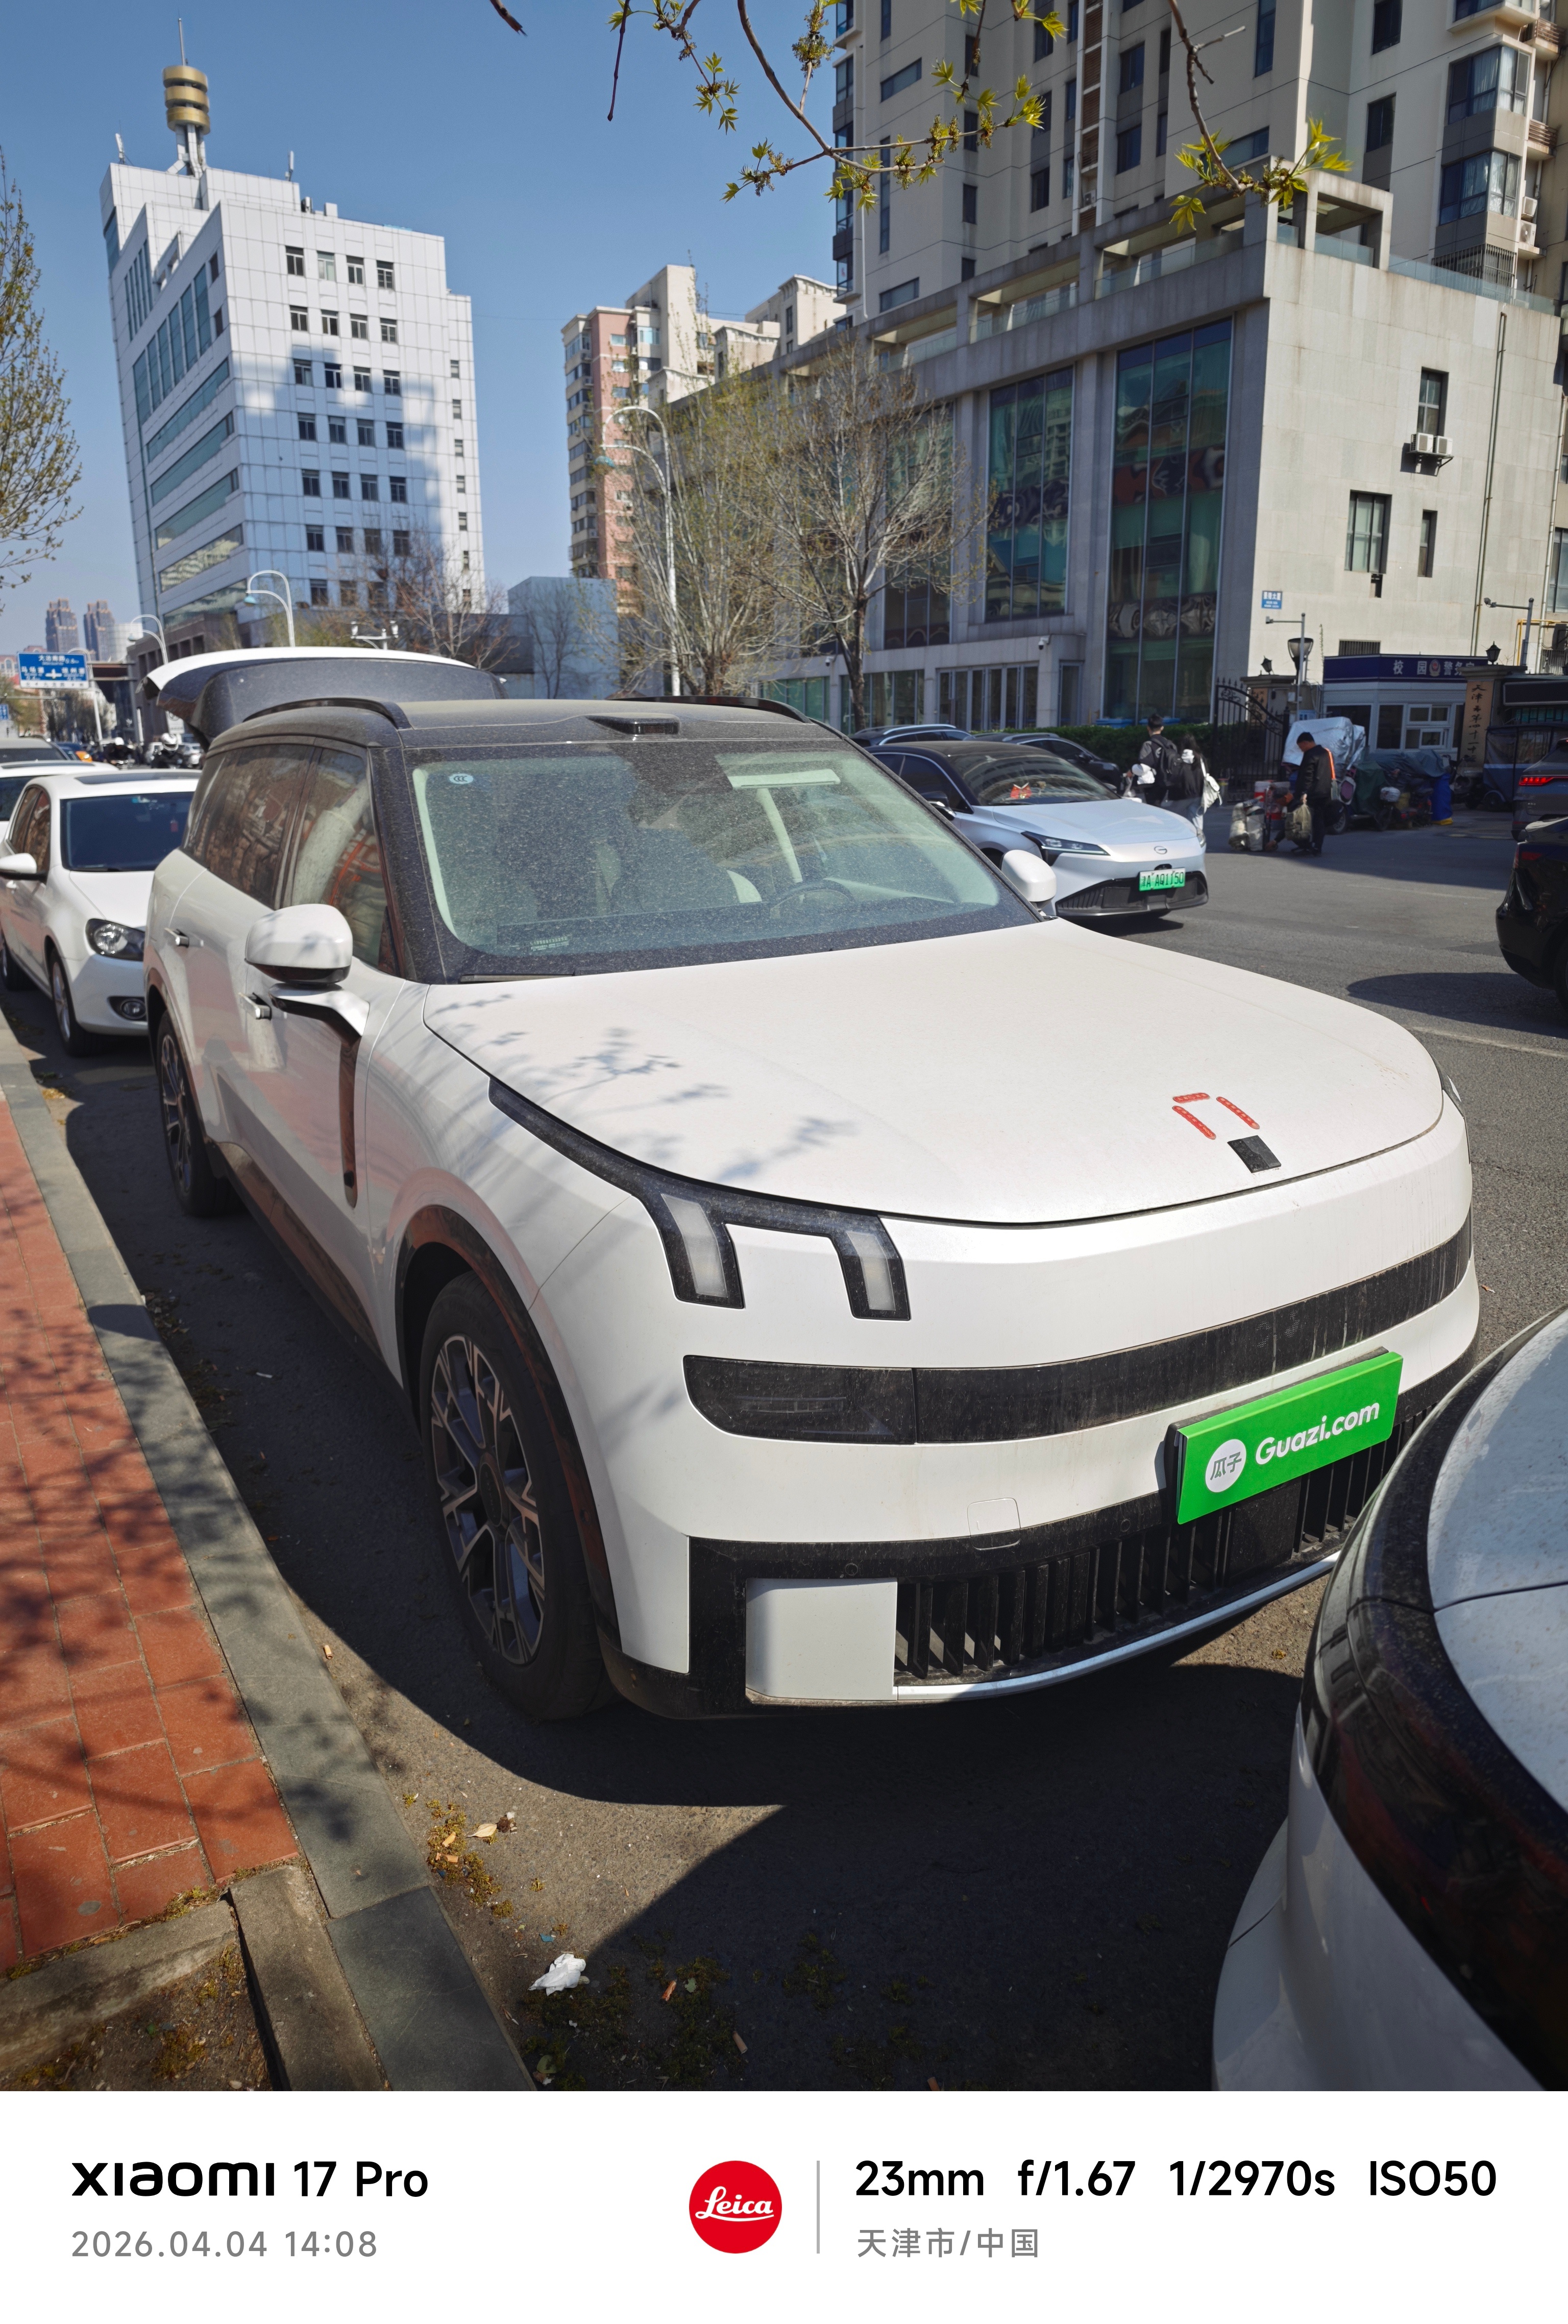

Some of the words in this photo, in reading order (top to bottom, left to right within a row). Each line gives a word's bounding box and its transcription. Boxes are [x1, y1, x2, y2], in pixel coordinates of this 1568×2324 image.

[1464, 685, 1486, 761] 天津市第四十一中
[1256, 1402, 1380, 1465] Guazi.com
[1210, 1451, 1242, 1481] 瓜子
